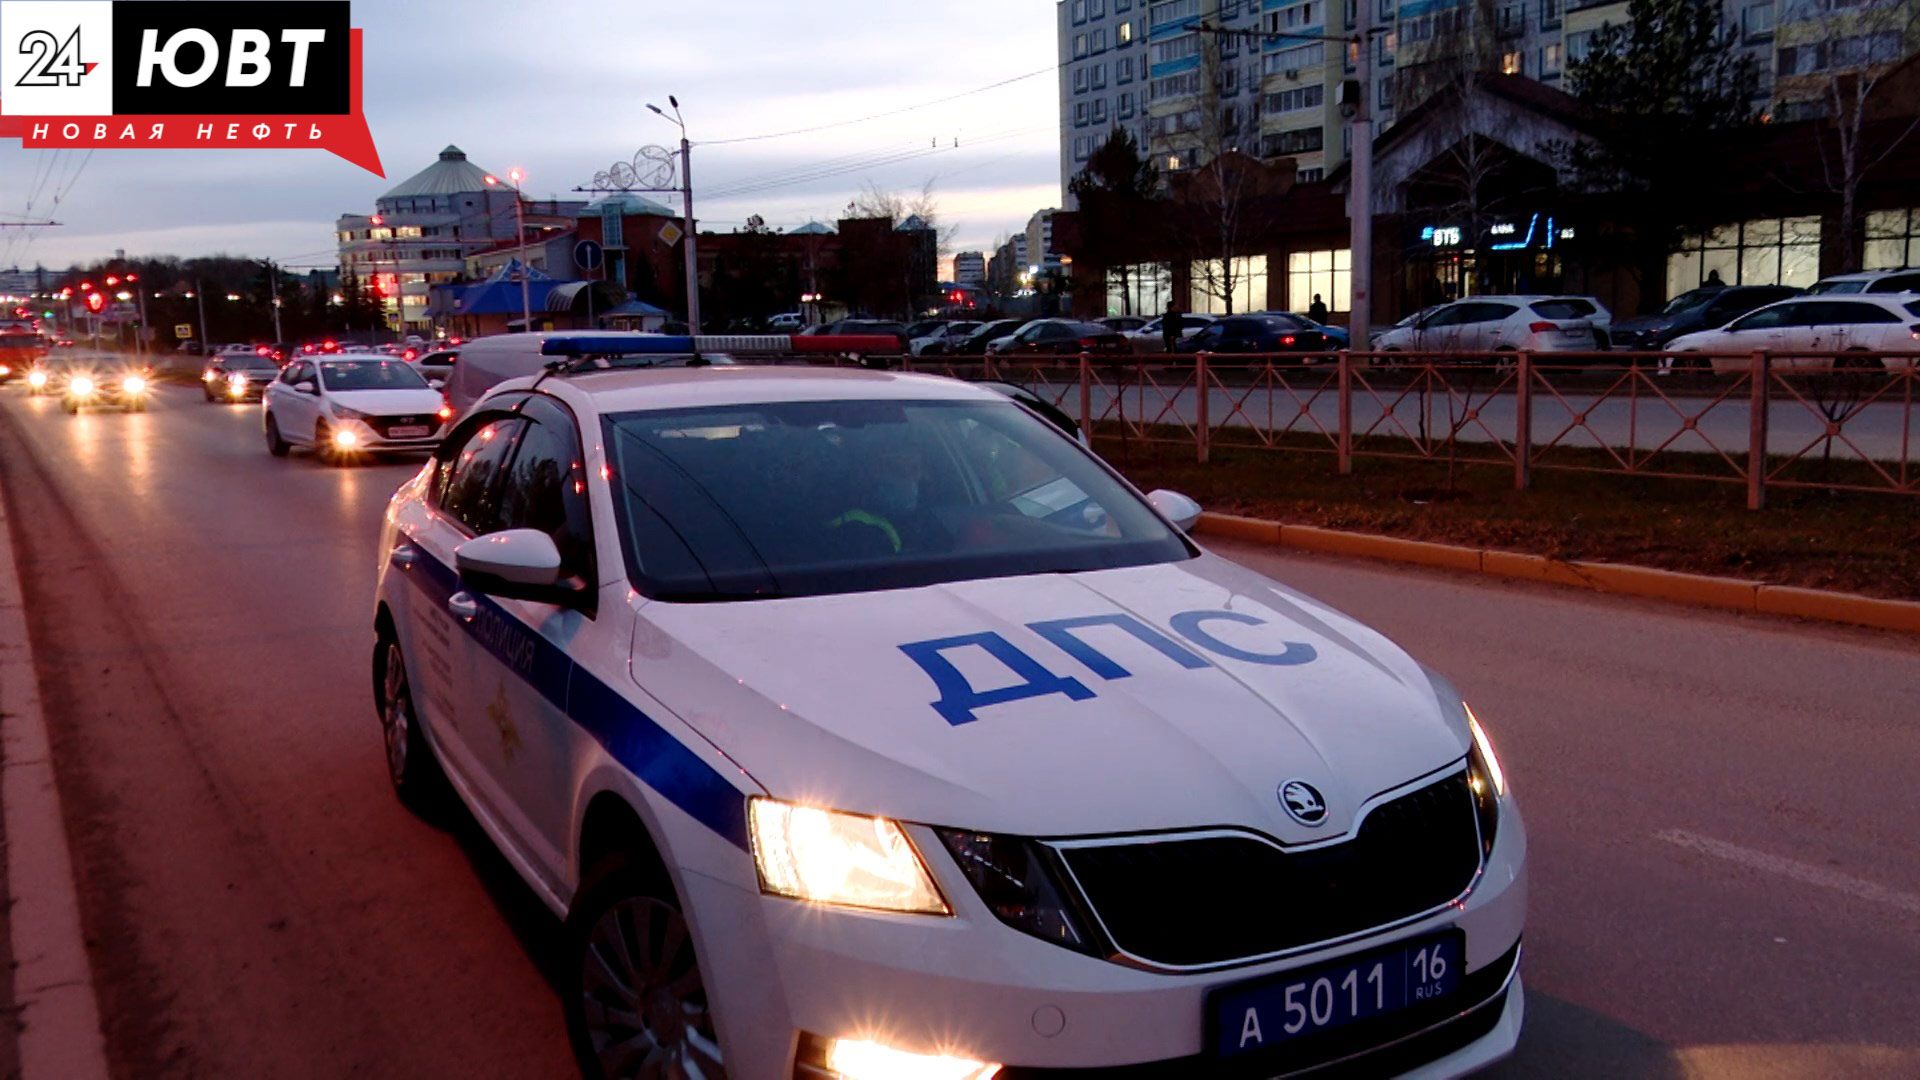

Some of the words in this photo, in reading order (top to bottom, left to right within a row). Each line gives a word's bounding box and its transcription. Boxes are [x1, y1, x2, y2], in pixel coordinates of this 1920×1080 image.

[896, 609, 1318, 726] ДПС
[1282, 962, 1384, 1035] 5011
[1412, 943, 1447, 984] 16
[1415, 981, 1443, 1000] RUS
